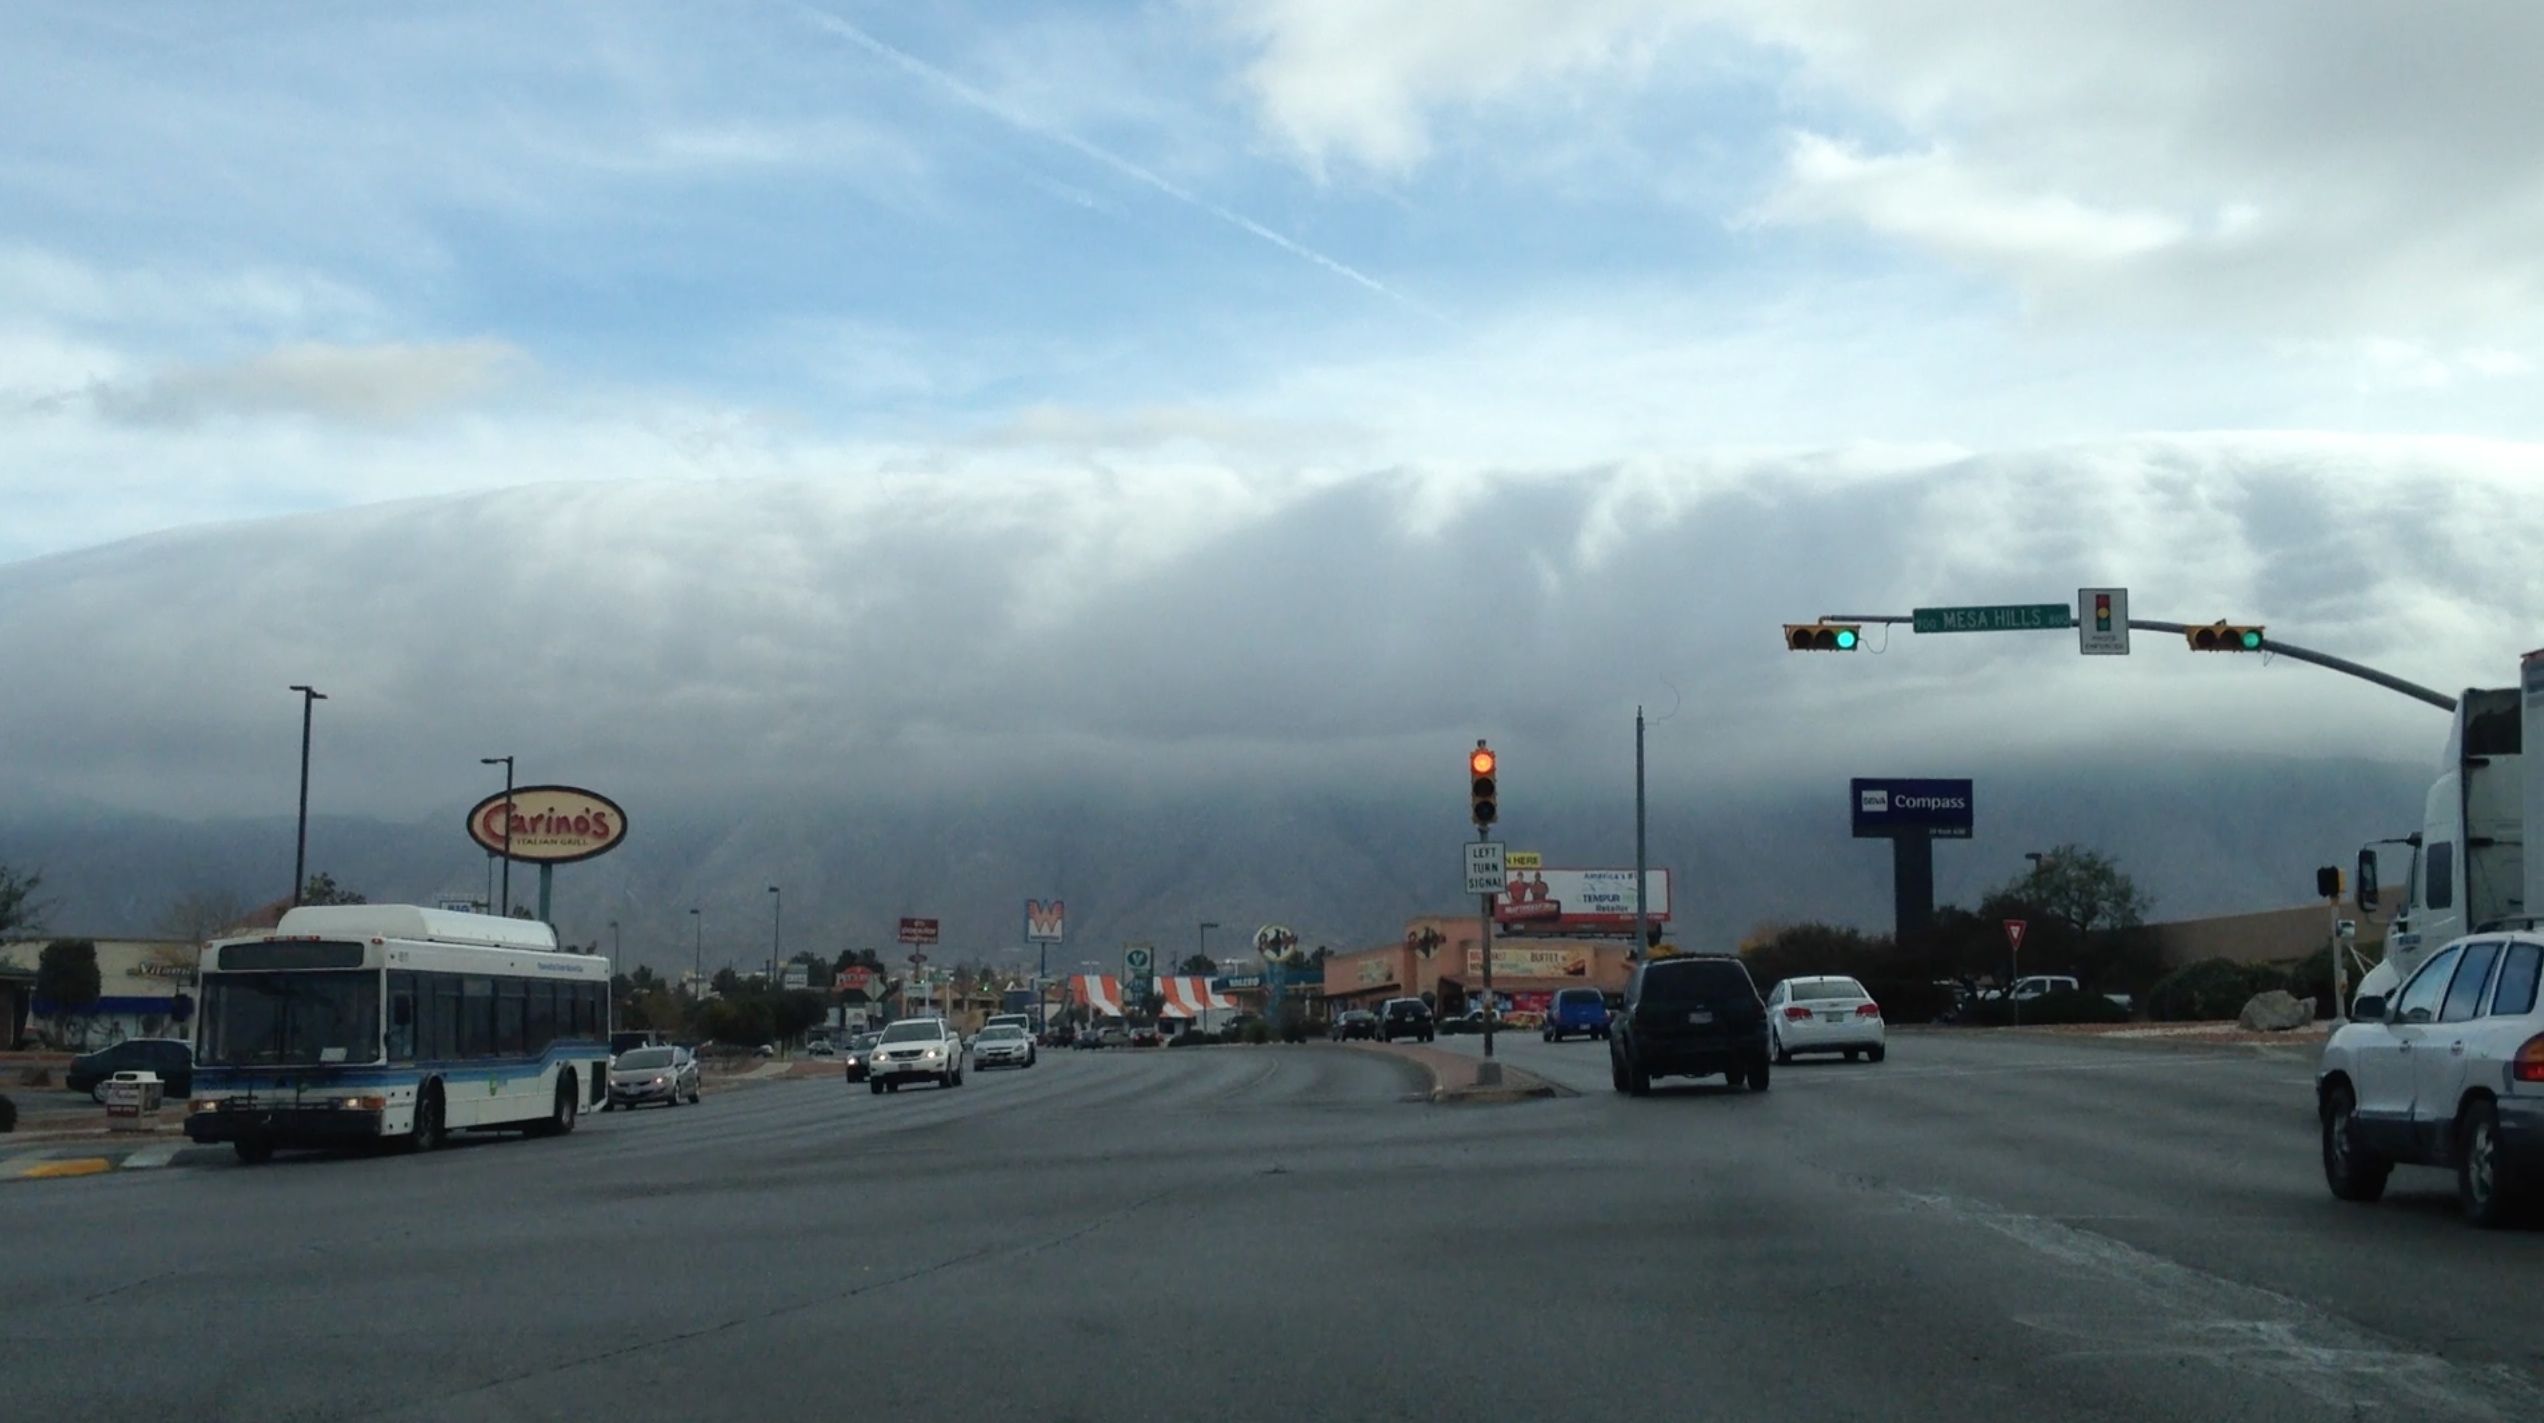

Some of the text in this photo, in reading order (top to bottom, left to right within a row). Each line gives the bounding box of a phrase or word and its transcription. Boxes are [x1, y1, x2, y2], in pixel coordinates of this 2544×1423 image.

[1943, 611, 1989, 629] MESA
[1994, 608, 2041, 626] HILLS
[1895, 794, 1966, 811] Compass
[516, 837, 588, 846] ITALIAN GRILL
[1472, 847, 1497, 859] LEFT
[1513, 856, 1539, 866] HERE
[1472, 862, 1499, 873] TURN
[1468, 877, 1503, 889] SIGNAL
[1582, 894, 1621, 904] TEMPUR
